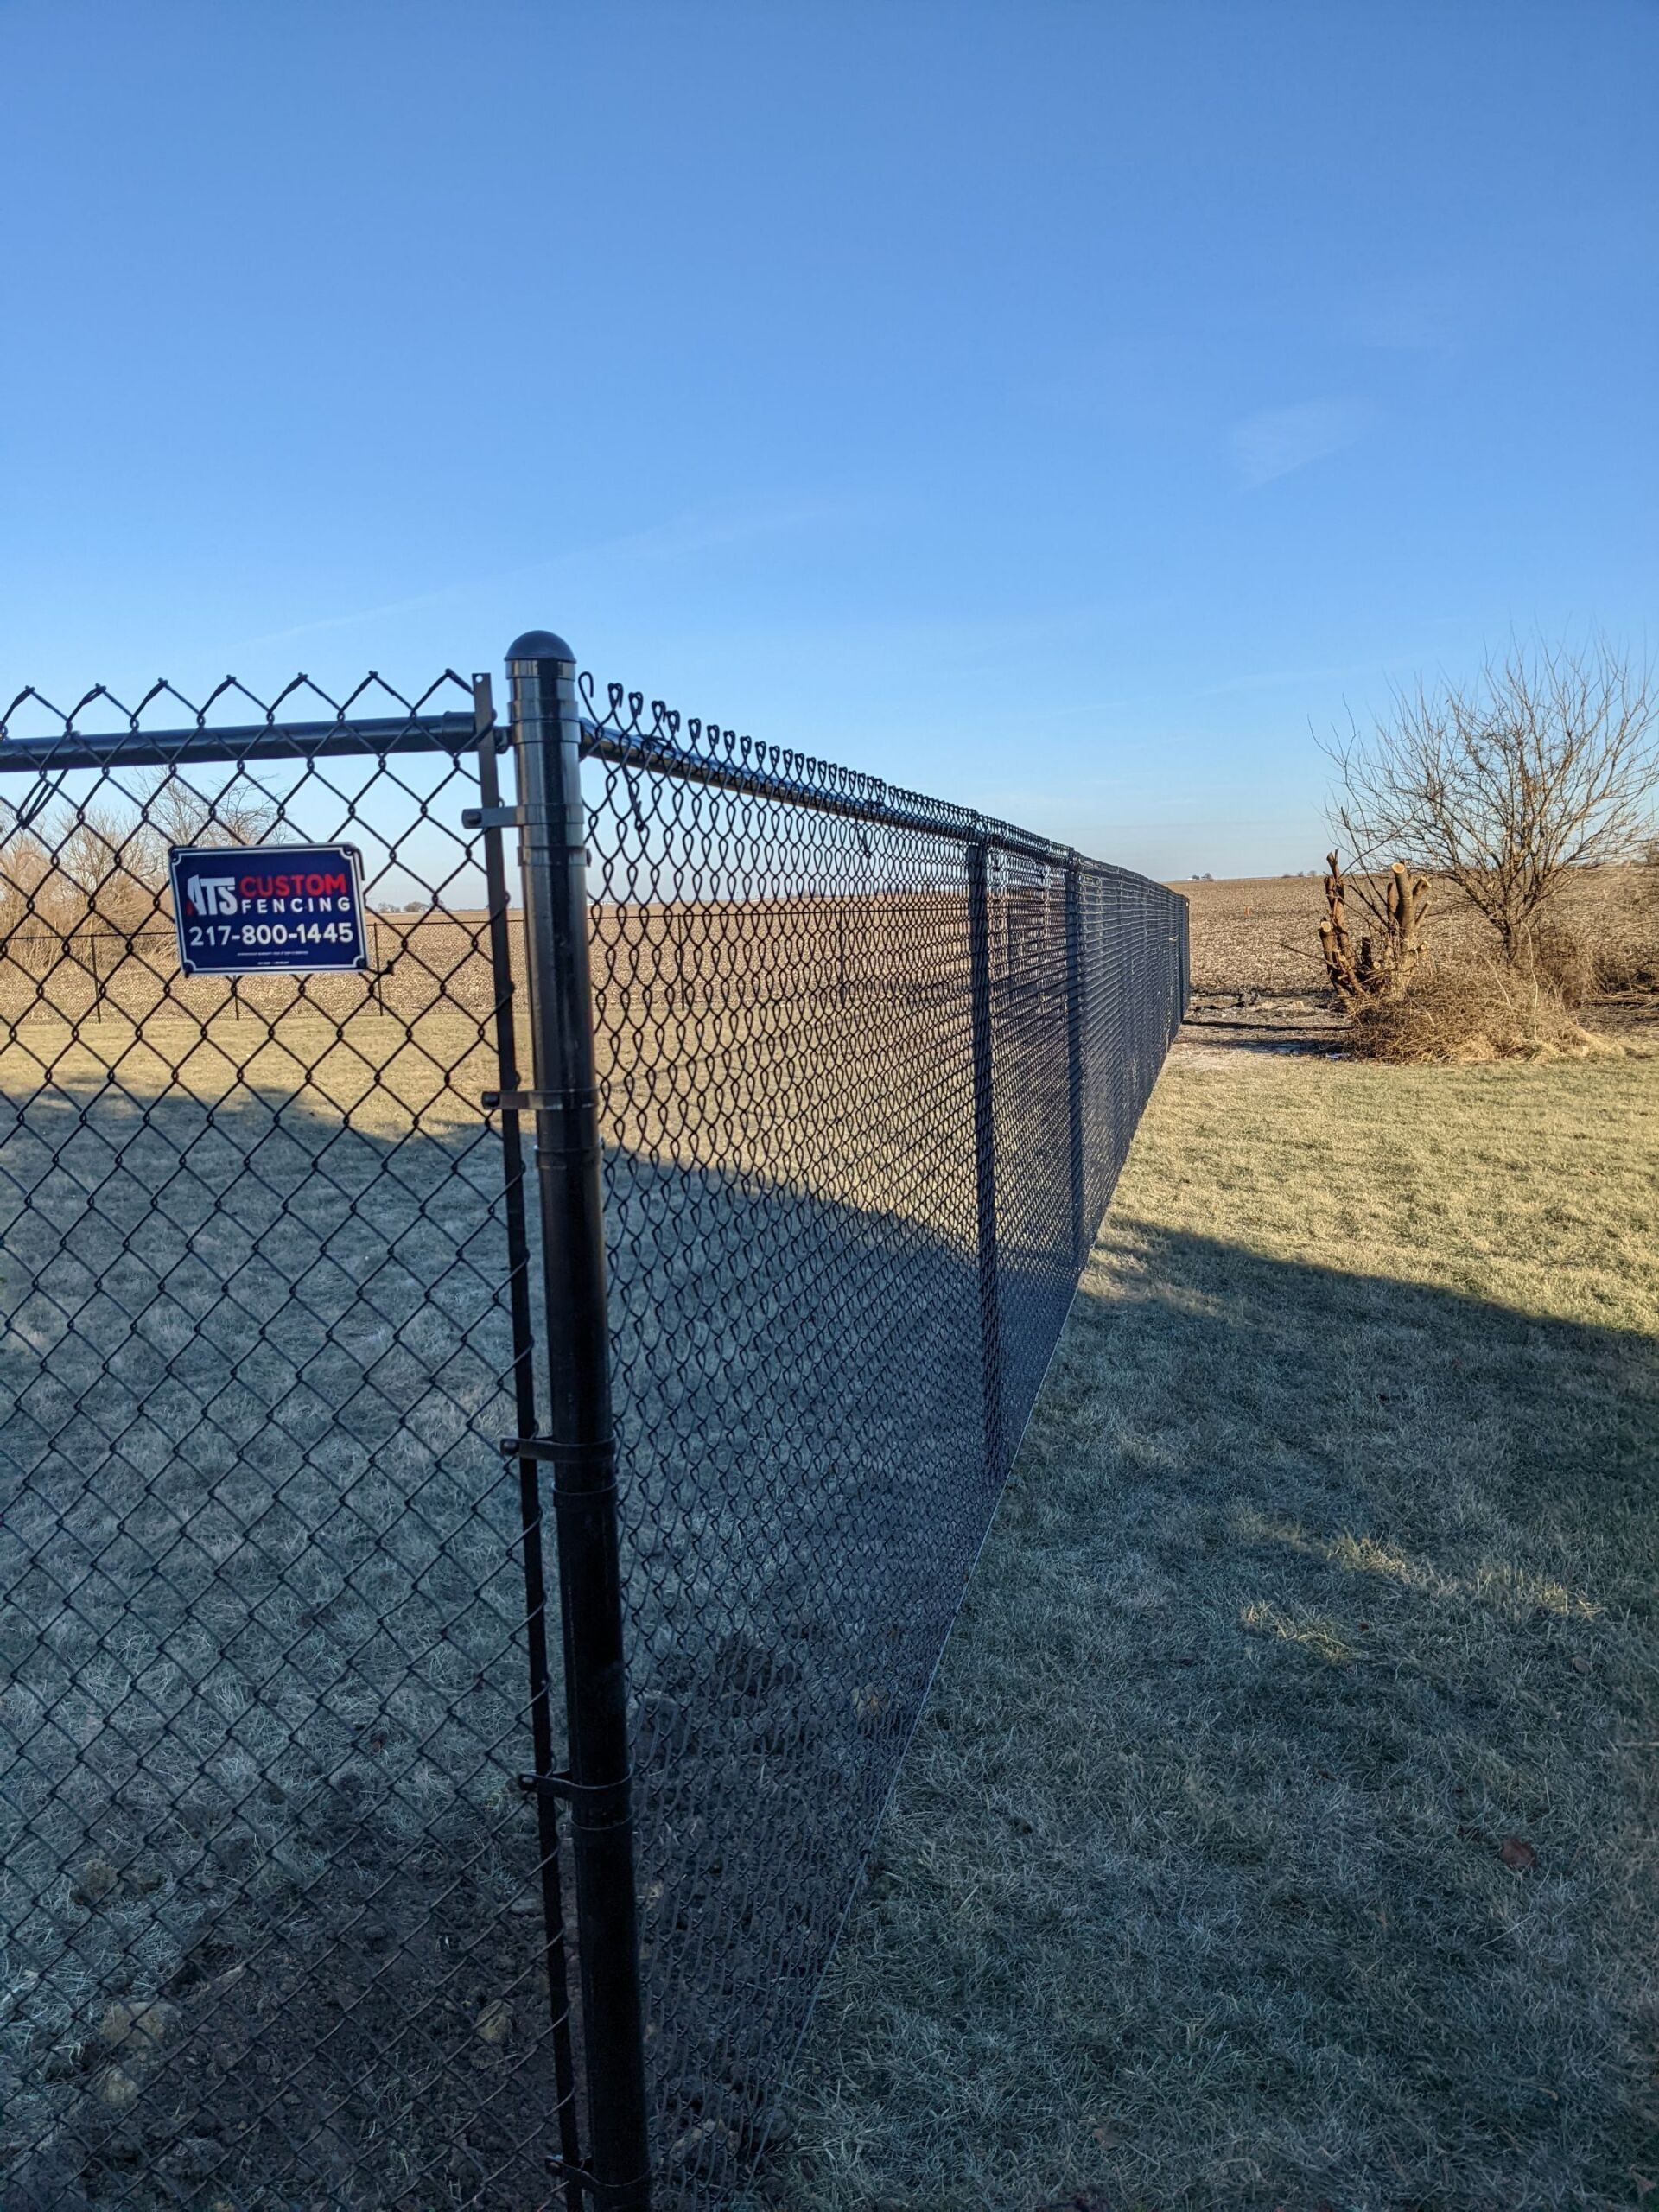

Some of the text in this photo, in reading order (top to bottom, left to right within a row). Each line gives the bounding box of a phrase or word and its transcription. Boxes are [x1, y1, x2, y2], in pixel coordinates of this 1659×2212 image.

[240, 874, 346, 897] CUSTOM
[242, 897, 351, 914] FENCING
[188, 923, 353, 946] 217-800-1445
